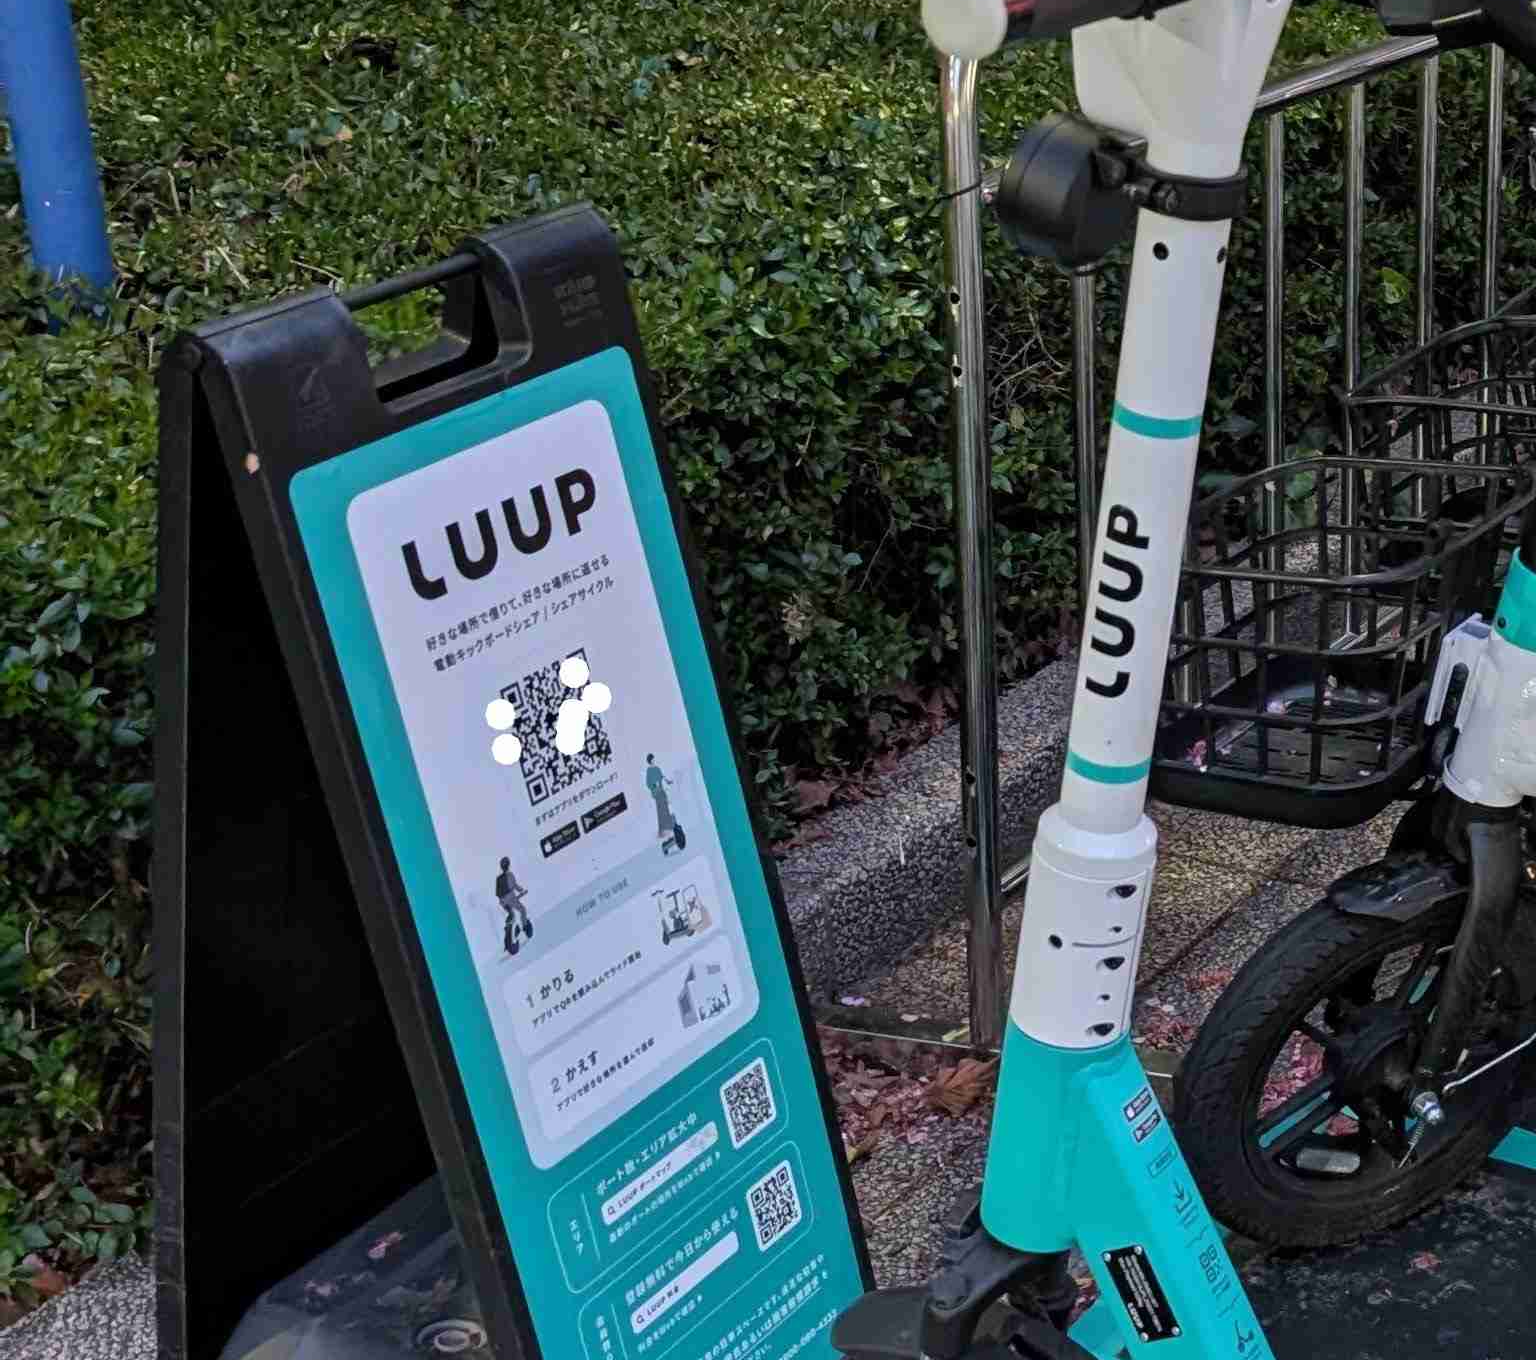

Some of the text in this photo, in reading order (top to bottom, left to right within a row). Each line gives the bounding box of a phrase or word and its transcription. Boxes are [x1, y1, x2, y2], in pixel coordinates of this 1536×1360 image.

[401, 468, 597, 600] LUUP
[426, 554, 609, 651] 好きな場所で借りて、好きな場所に返せる
[1086, 504, 1150, 698] LUUP
[540, 968, 574, 1000] かりる
[552, 1050, 599, 1093] 2 かえす
